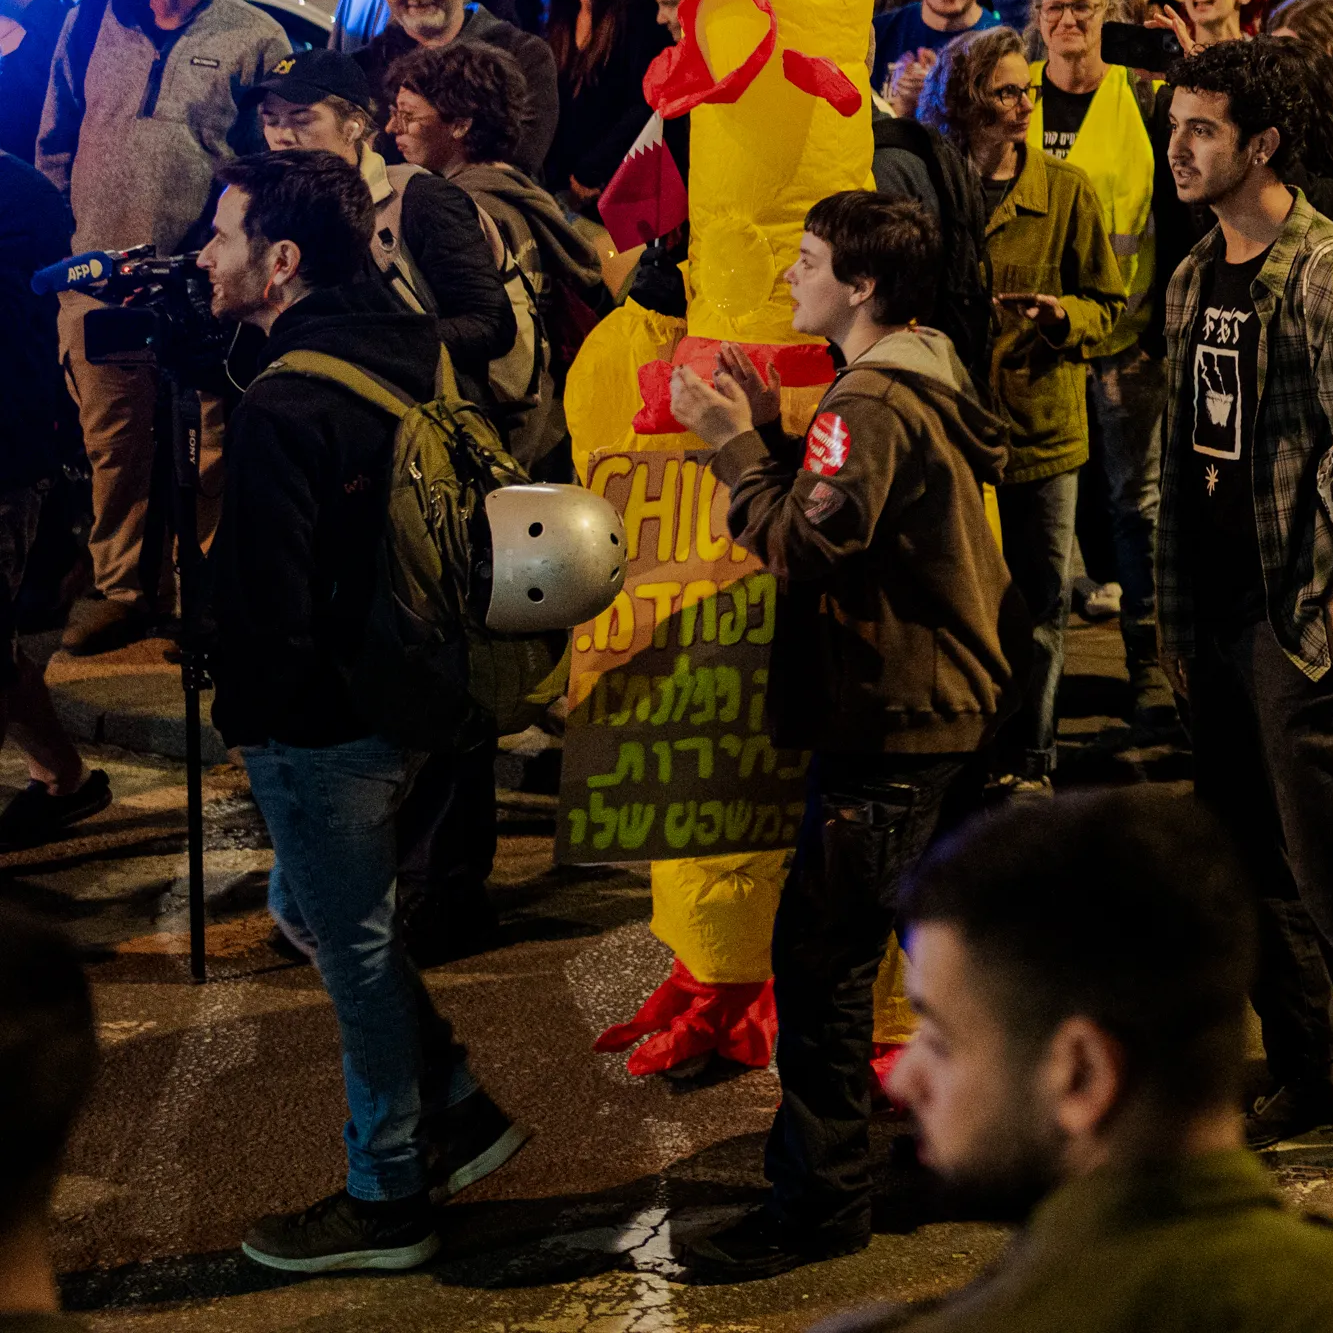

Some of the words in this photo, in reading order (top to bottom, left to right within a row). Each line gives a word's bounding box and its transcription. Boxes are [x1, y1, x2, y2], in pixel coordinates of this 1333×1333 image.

[67, 264, 90, 283] AFP
[188, 428, 197, 465] SONY
[588, 454, 751, 564] CHIC
[567, 790, 657, 851] שלו
